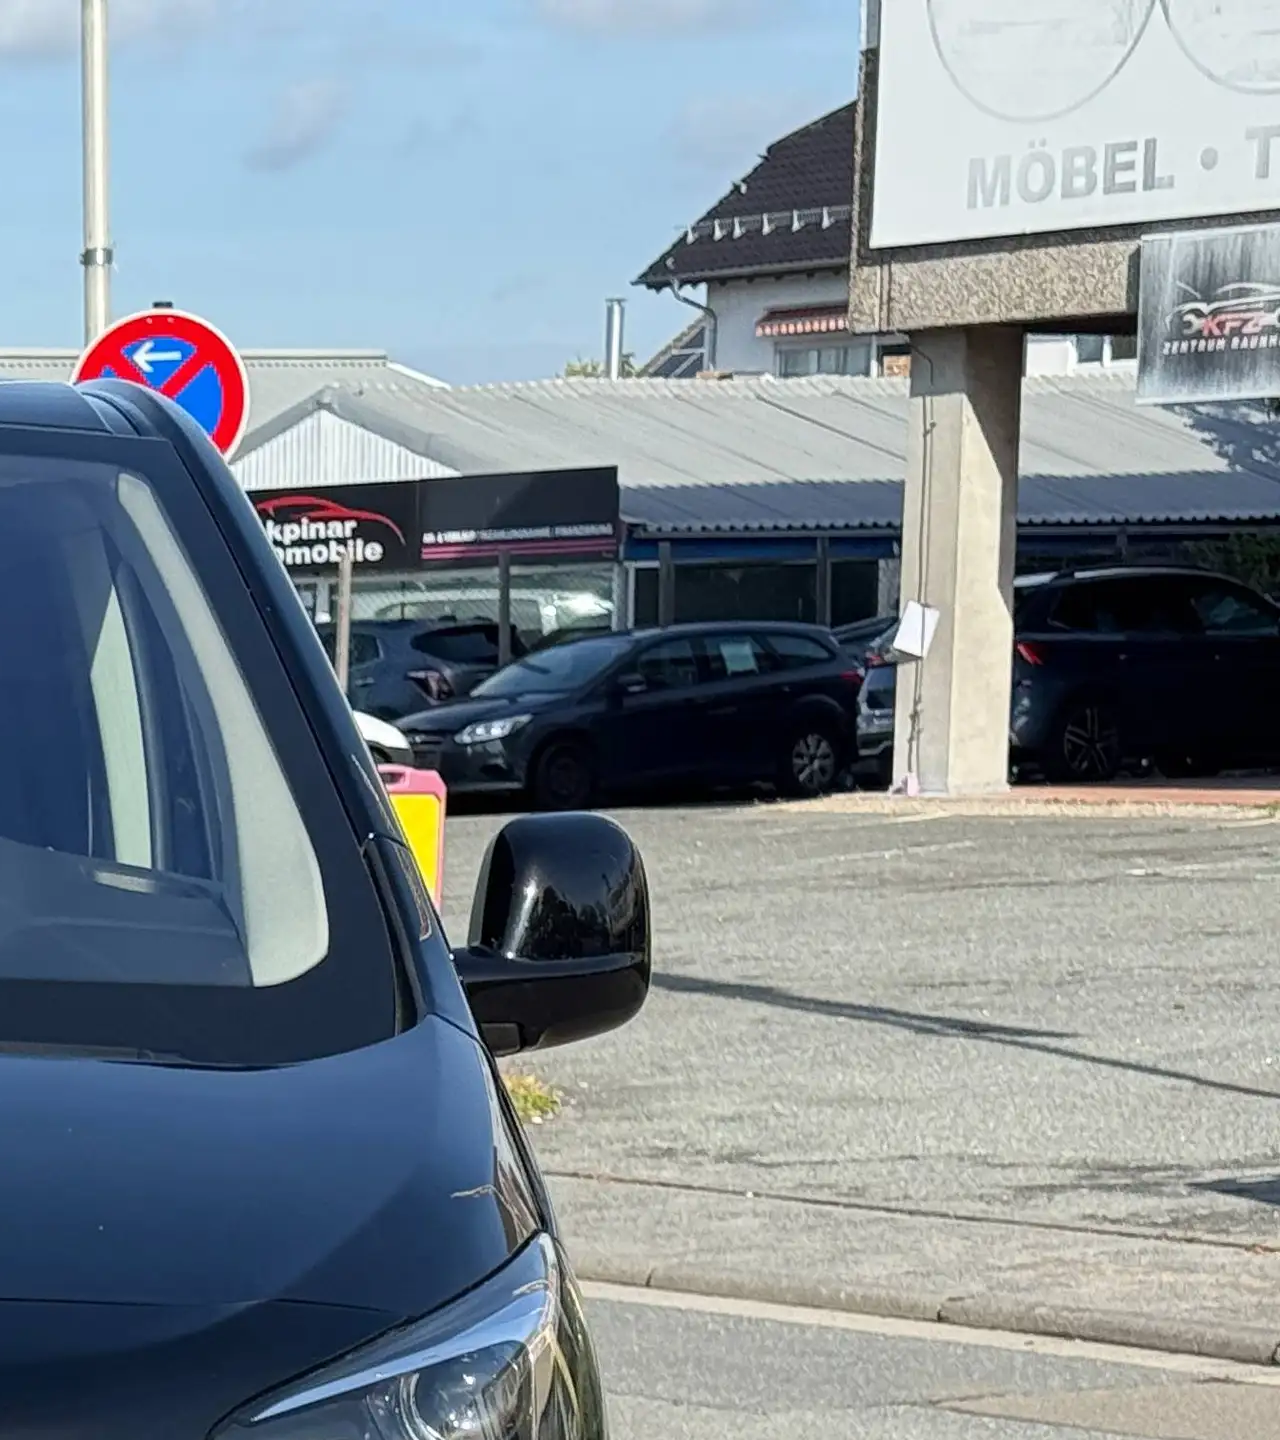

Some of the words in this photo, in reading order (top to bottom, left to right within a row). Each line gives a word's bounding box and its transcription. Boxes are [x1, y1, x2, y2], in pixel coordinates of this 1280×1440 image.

[967, 138, 1175, 209] MÖBEL
[1230, 334, 1280, 351] RAUNH
[265, 516, 358, 545] kpinar
[274, 538, 384, 565] omobile
